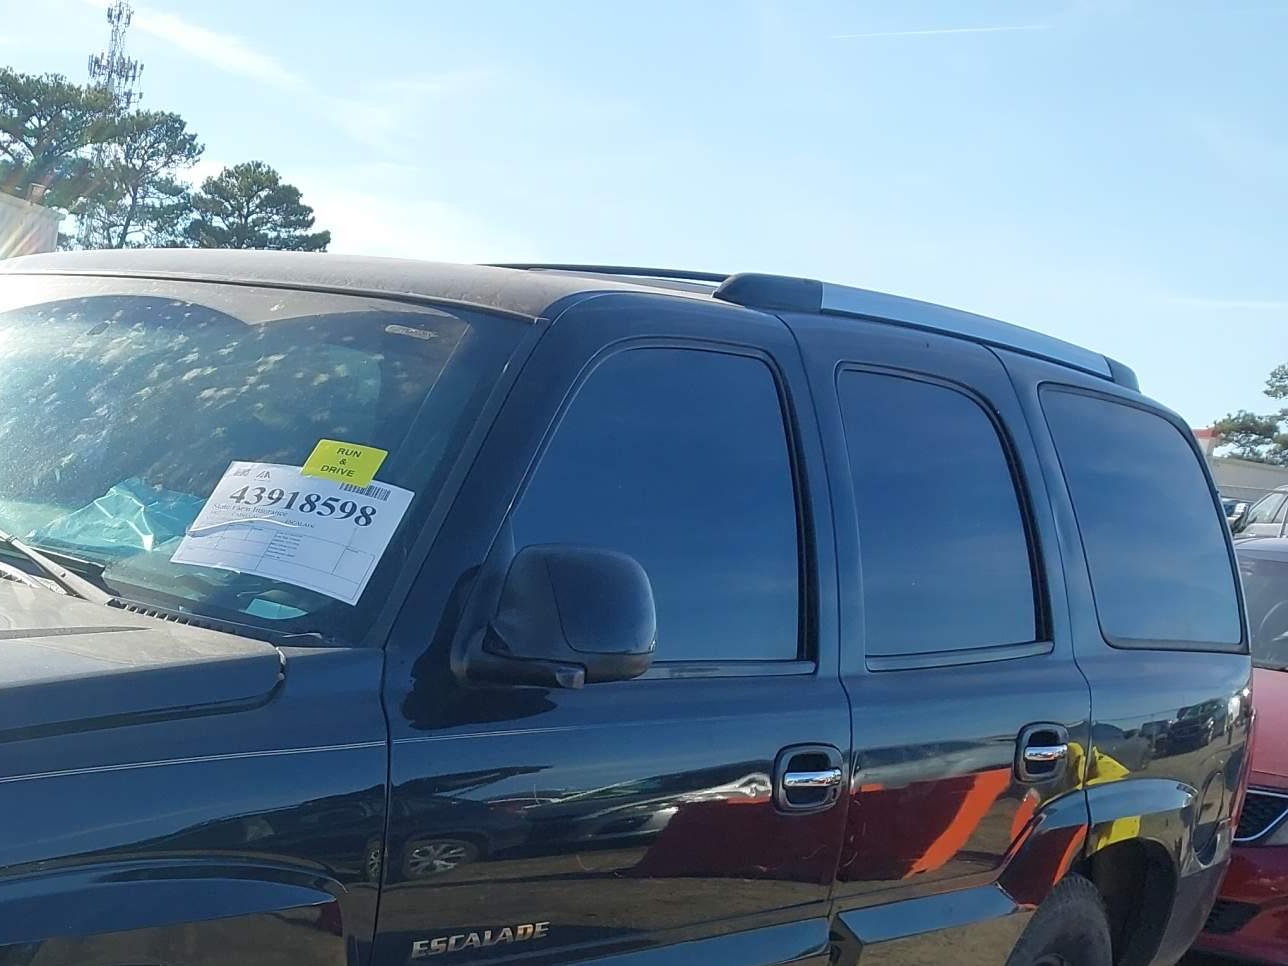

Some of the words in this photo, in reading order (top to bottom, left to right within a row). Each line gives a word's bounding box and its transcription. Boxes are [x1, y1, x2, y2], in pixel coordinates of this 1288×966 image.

[336, 447, 362, 458] RUN
[338, 458, 347, 466] &
[320, 464, 356, 478] DRIVE
[229, 485, 377, 528] 43918598
[411, 921, 550, 958] ESCALADE
